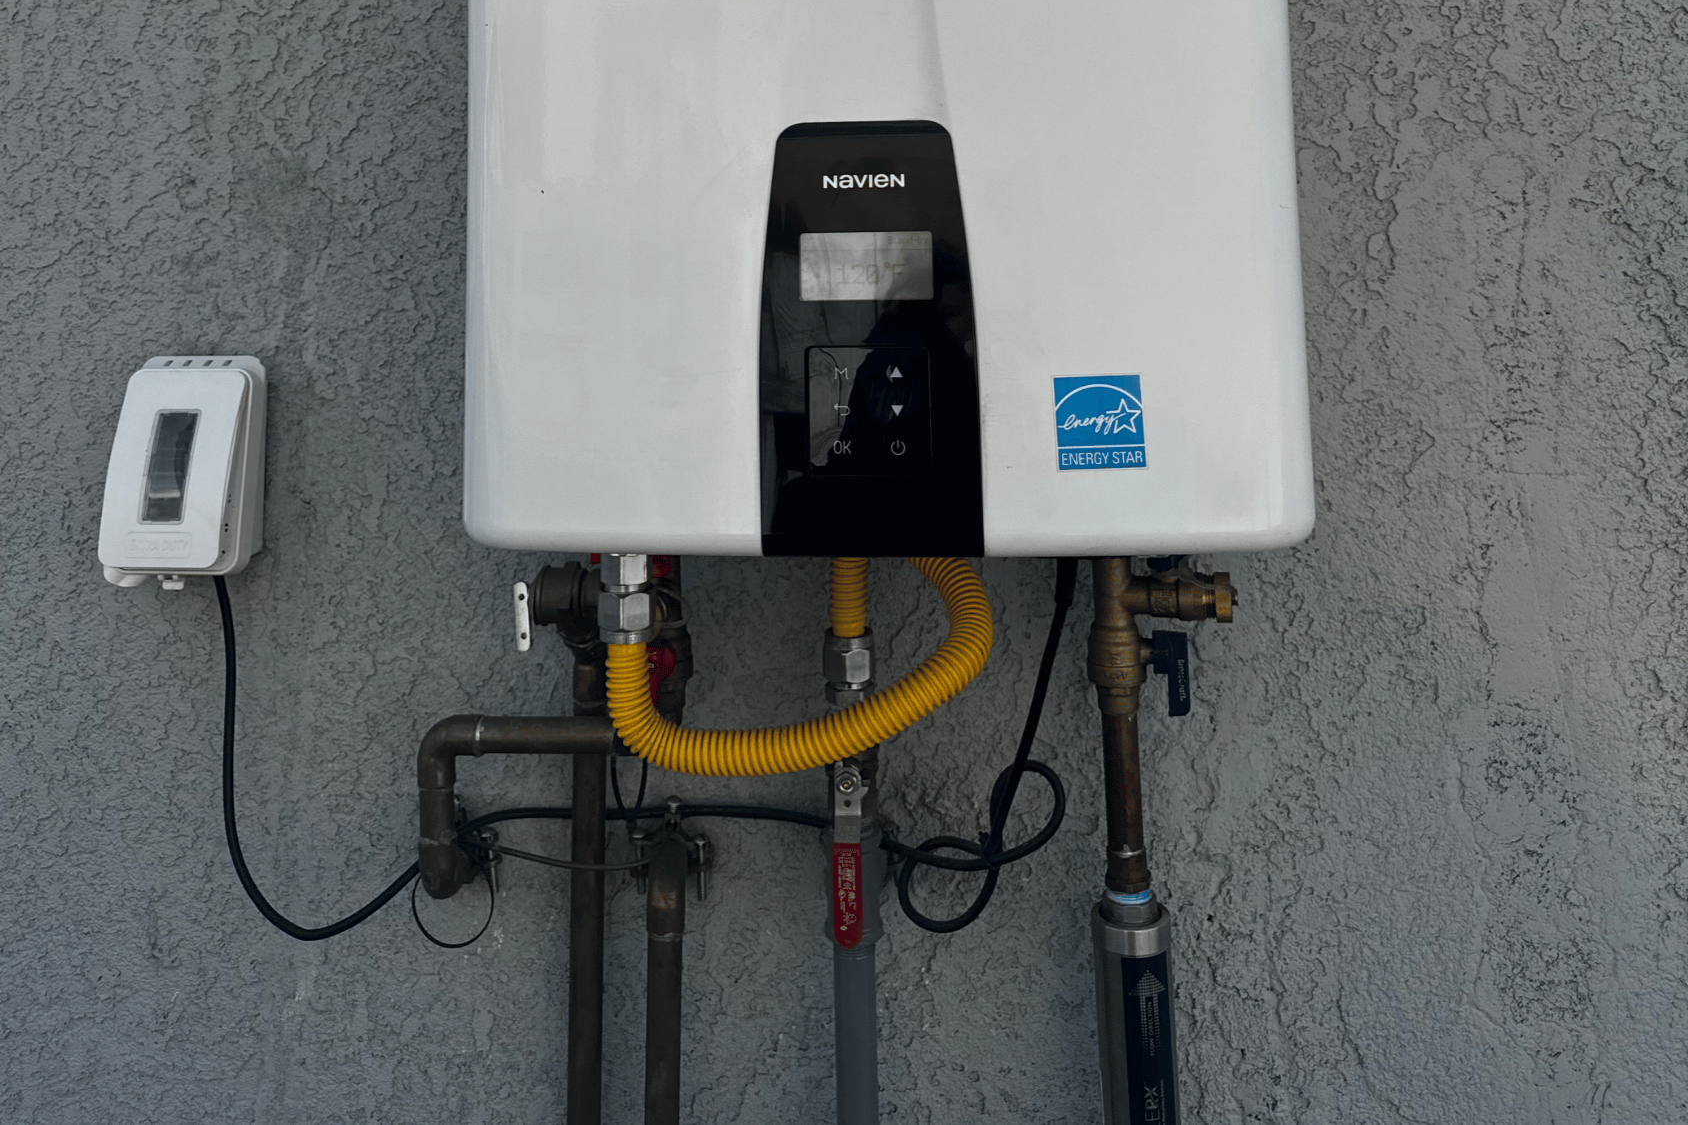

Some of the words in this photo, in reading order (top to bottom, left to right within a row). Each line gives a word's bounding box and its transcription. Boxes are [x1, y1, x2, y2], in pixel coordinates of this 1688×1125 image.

[833, 367, 849, 380] M
[1058, 413, 1120, 435] energy
[833, 440, 852, 455] OK
[1061, 452, 1110, 466] ENERGY
[1112, 450, 1143, 465] STAR
[1143, 1085, 1161, 1125] ERX
